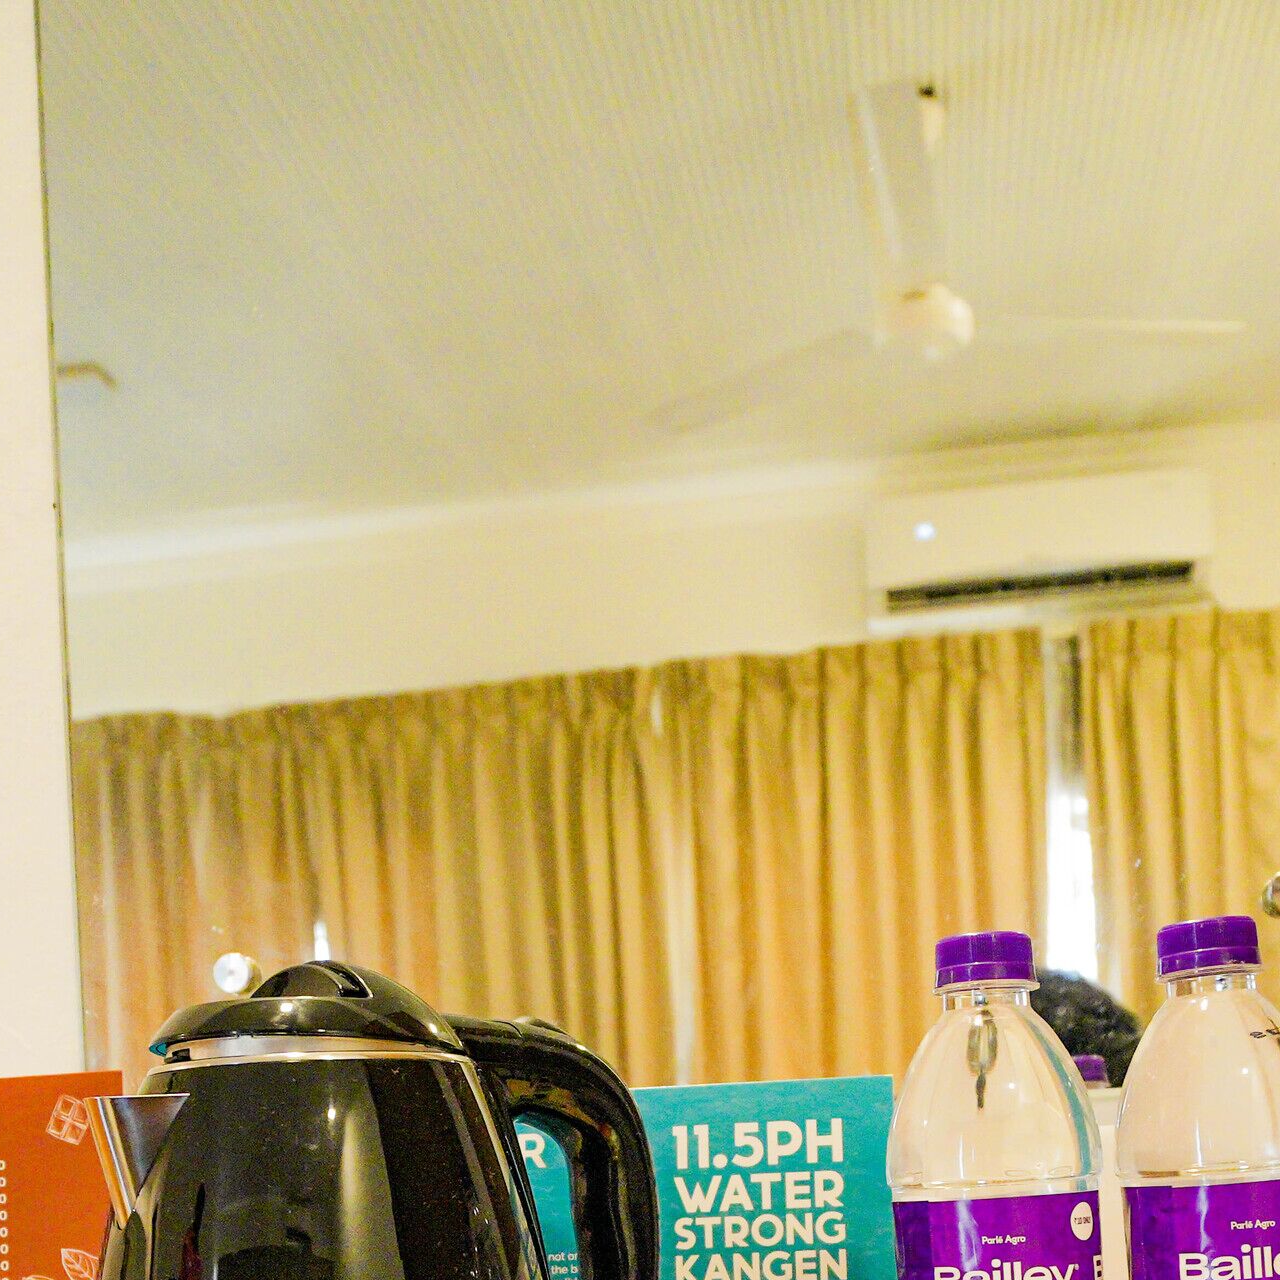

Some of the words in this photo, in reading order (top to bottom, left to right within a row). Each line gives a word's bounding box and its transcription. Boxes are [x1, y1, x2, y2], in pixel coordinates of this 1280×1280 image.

[672, 1118, 844, 1170] 11.5PH
[673, 1170, 845, 1214] WATER
[675, 1211, 847, 1250] STRONG
[1004, 1234, 1027, 1246] Agro
[1254, 1219, 1276, 1230] Agro
